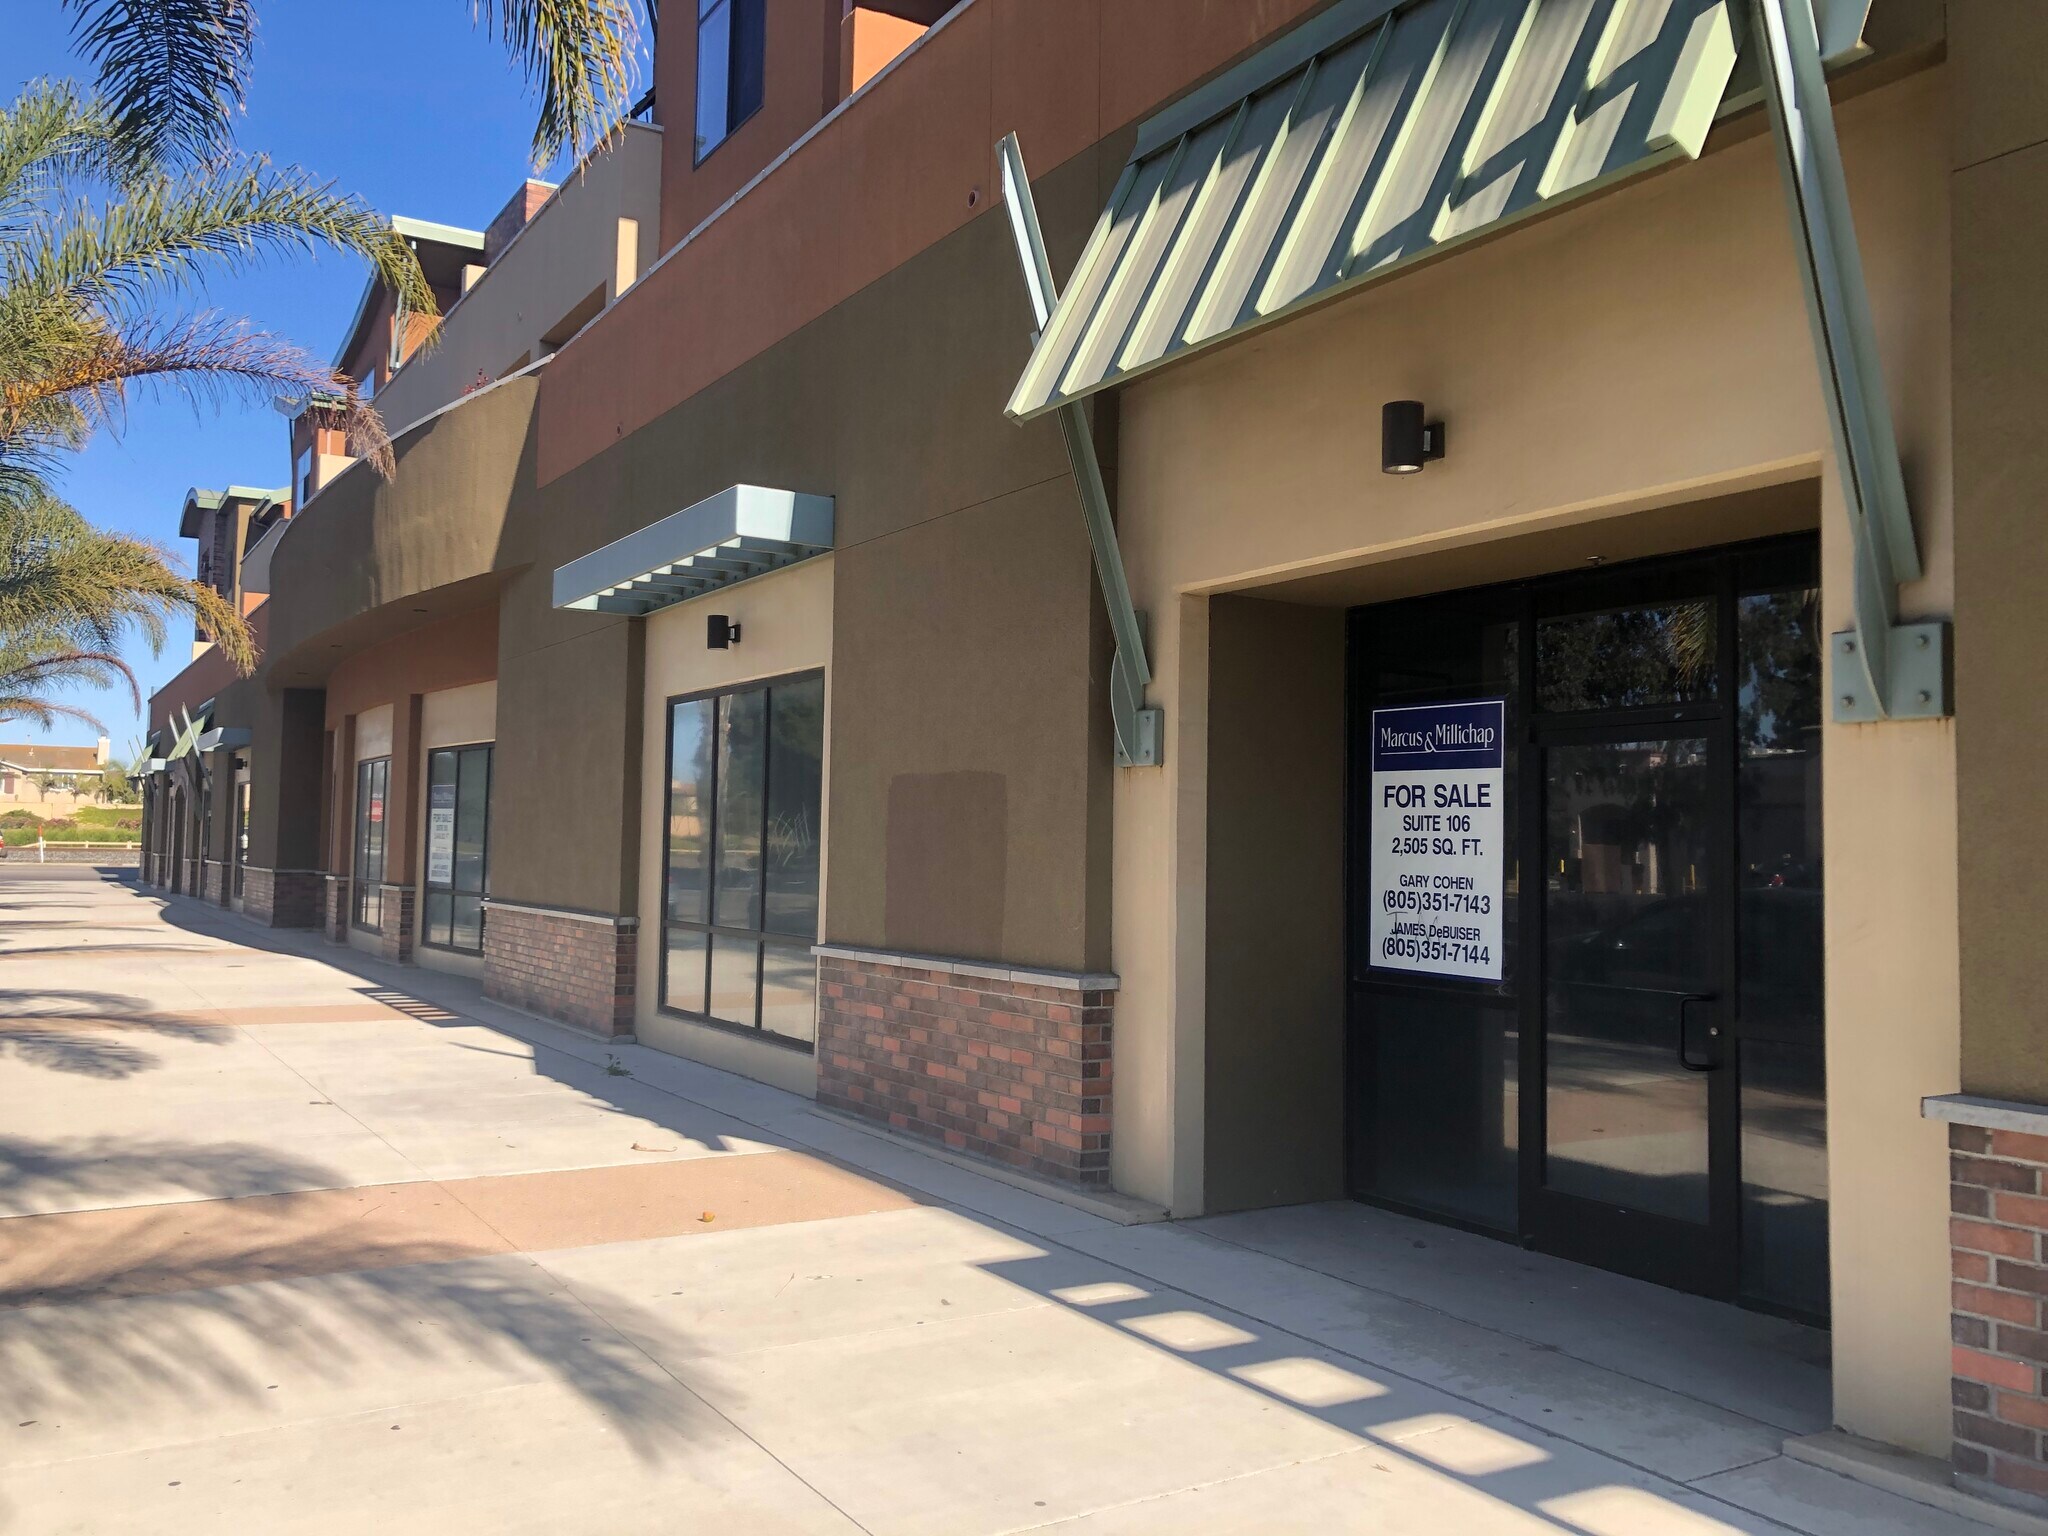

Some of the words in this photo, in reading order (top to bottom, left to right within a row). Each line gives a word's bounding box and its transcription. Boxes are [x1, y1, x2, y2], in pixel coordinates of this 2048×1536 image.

[1381, 727, 1423, 749] Marcus
[1425, 731, 1436, 752] &
[1436, 723, 1494, 749] Millichap
[1384, 784, 1426, 808] FOR
[1434, 783, 1491, 808] SALE
[1403, 815, 1441, 832] SUITE
[1446, 815, 1471, 832] 106
[1391, 837, 1428, 857] 2,505
[1432, 838, 1457, 856] SQ.
[1462, 839, 1483, 856] FT.
[1399, 874, 1429, 888] GARY
[1433, 876, 1474, 890] COHEN
[1383, 890, 1491, 915] (805)351-7143
[1391, 922, 1426, 937] JAMES
[1429, 924, 1481, 941] DeBUISER
[1383, 938, 1490, 965] (805)351-7144
